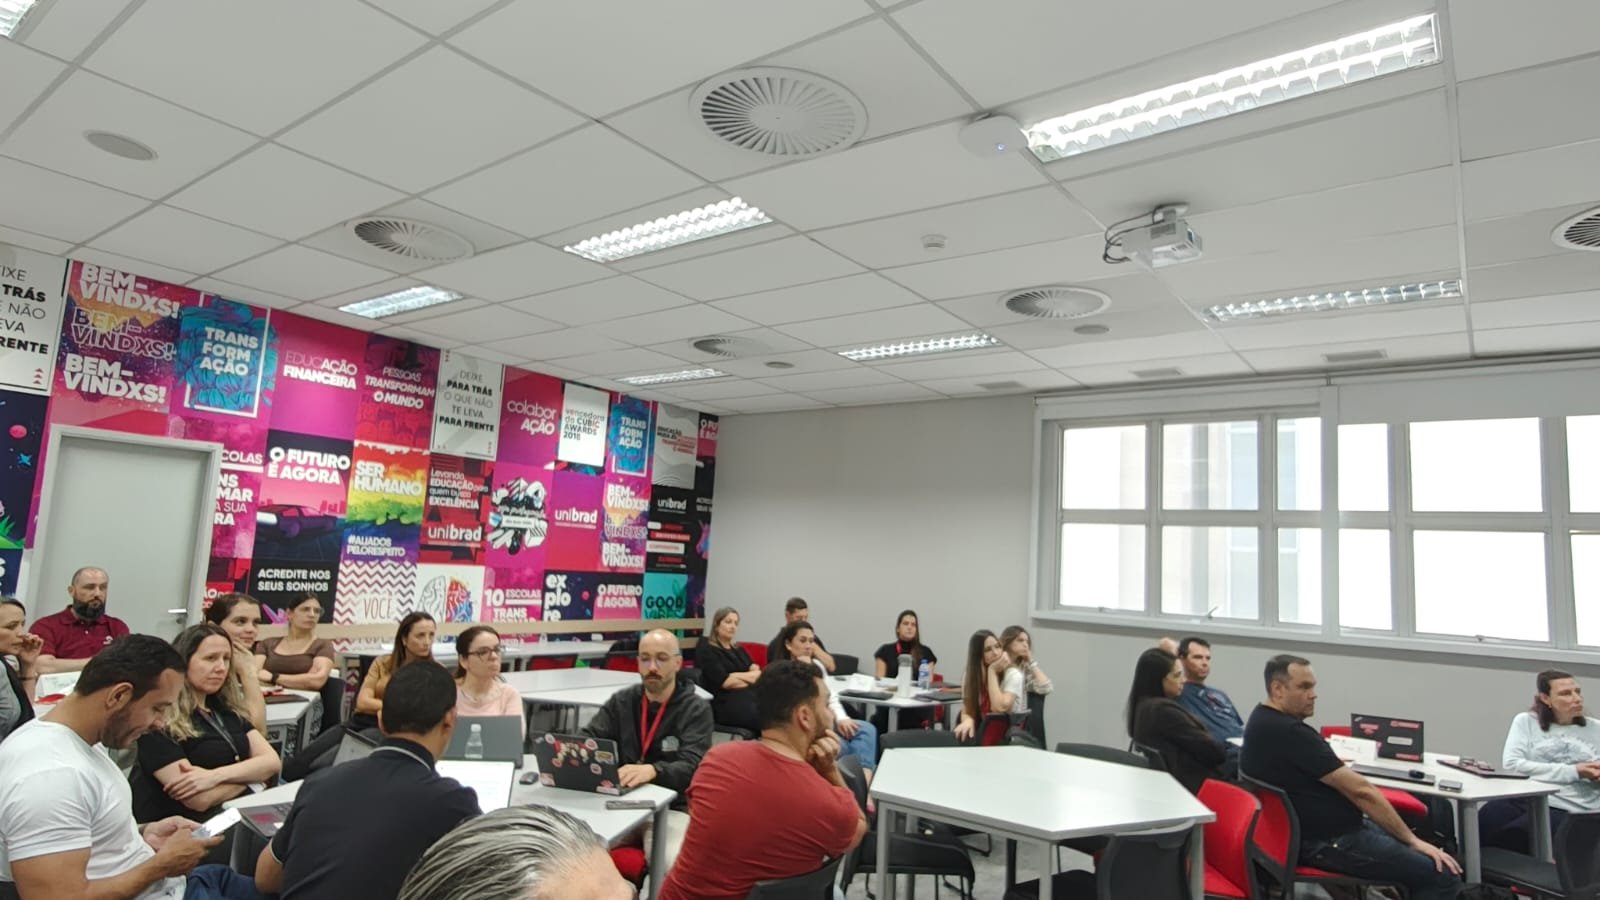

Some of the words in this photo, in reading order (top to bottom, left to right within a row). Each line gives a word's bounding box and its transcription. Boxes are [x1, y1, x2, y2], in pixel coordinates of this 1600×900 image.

[81, 263, 148, 291] BEM-
[2, 284, 46, 302] TRÁS
[80, 281, 180, 319] VINDXS!
[8, 302, 46, 320] NÃO
[71, 324, 176, 361] VINDXS!
[205, 326, 258, 349] TRANS
[203, 342, 251, 362] FORM
[65, 353, 134, 378] BEM-
[200, 358, 249, 376] AÇÃO
[285, 351, 358, 375] EDUCAÇÃO
[283, 364, 357, 390] FINANCEIRA
[382, 365, 423, 382] PESSOAS
[63, 371, 167, 403] VINDXS!
[365, 374, 435, 397] TRANSFORMAM
[447, 379, 470, 392] PARA
[472, 384, 493, 396] TRÁS
[373, 390, 384, 402] O
[385, 392, 424, 409] MUNDO
[444, 391, 453, 401] O
[452, 405, 461, 414] TE
[463, 407, 485, 418] LEVA
[507, 400, 557, 421] colabor
[439, 416, 462, 427] PARA
[464, 420, 495, 432] FRENTE
[521, 418, 556, 436] AÇÃO
[270, 446, 286, 462] O
[287, 448, 351, 470] FUTURO
[268, 460, 280, 478] É
[280, 466, 341, 485] AGORA
[356, 460, 386, 479] SER
[354, 475, 424, 497] HUMANO
[430, 477, 474, 491] EDUCAÇÃO
[607, 483, 635, 497] BEM-
[224, 502, 248, 513] SUA
[657, 498, 687, 510] unibrad
[555, 507, 598, 523] unibrad
[428, 523, 482, 540] unibrad
[602, 541, 631, 556] BEM-
[257, 568, 309, 580] ACREDITE
[309, 569, 332, 581] NOS
[545, 574, 567, 589] ex
[257, 581, 285, 592] SEUS
[286, 582, 329, 592] SONHOS
[597, 584, 606, 596] O
[607, 584, 643, 596] FUTURO
[484, 588, 505, 607] 10
[505, 589, 542, 599] ESCOLAS
[544, 584, 572, 610] plo
[603, 595, 638, 608] AGORA
[645, 595, 684, 609] GOOD
[493, 607, 528, 620] TRANS
